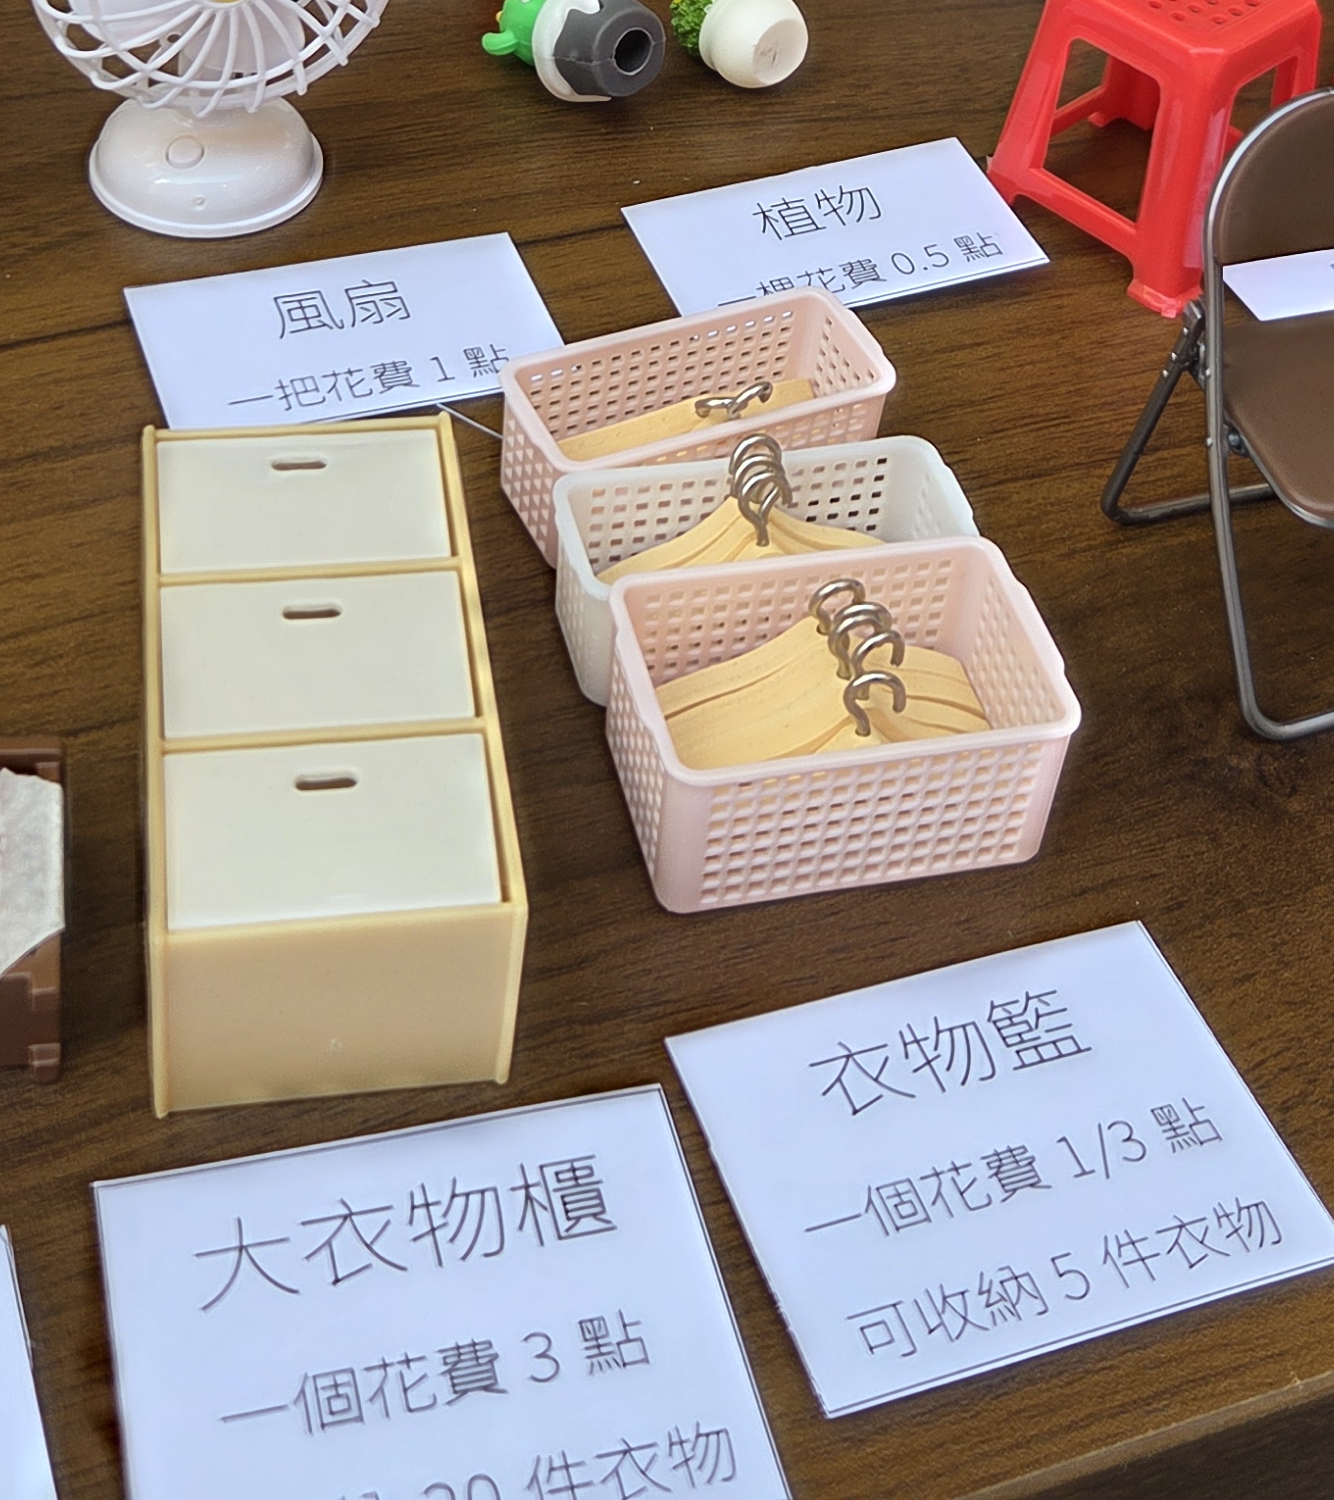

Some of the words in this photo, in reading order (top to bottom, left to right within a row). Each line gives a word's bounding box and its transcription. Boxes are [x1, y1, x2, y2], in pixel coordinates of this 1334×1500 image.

[752, 185, 882, 241] 植物
[891, 243, 950, 276] 0.5
[954, 231, 1004, 261] 點
[272, 279, 412, 339] 風扇
[227, 359, 420, 412] 一把花費
[430, 356, 457, 382] 1
[463, 343, 509, 379] 點
[808, 989, 1093, 1118] 衣物籃
[803, 1144, 1053, 1240] 一個花費
[1055, 1118, 1148, 1182] 1/3
[1150, 1096, 1224, 1154] 點
[192, 1153, 618, 1313] 大衣物櫃
[845, 1264, 1050, 1361] 可收納
[1053, 1251, 1093, 1304] 5
[1101, 1196, 1285, 1291] 件衣物
[218, 1337, 509, 1435] 一個花費
[521, 1331, 561, 1383] 3
[577, 1309, 651, 1376] 點
[525, 1420, 739, 1500] 件衣物
